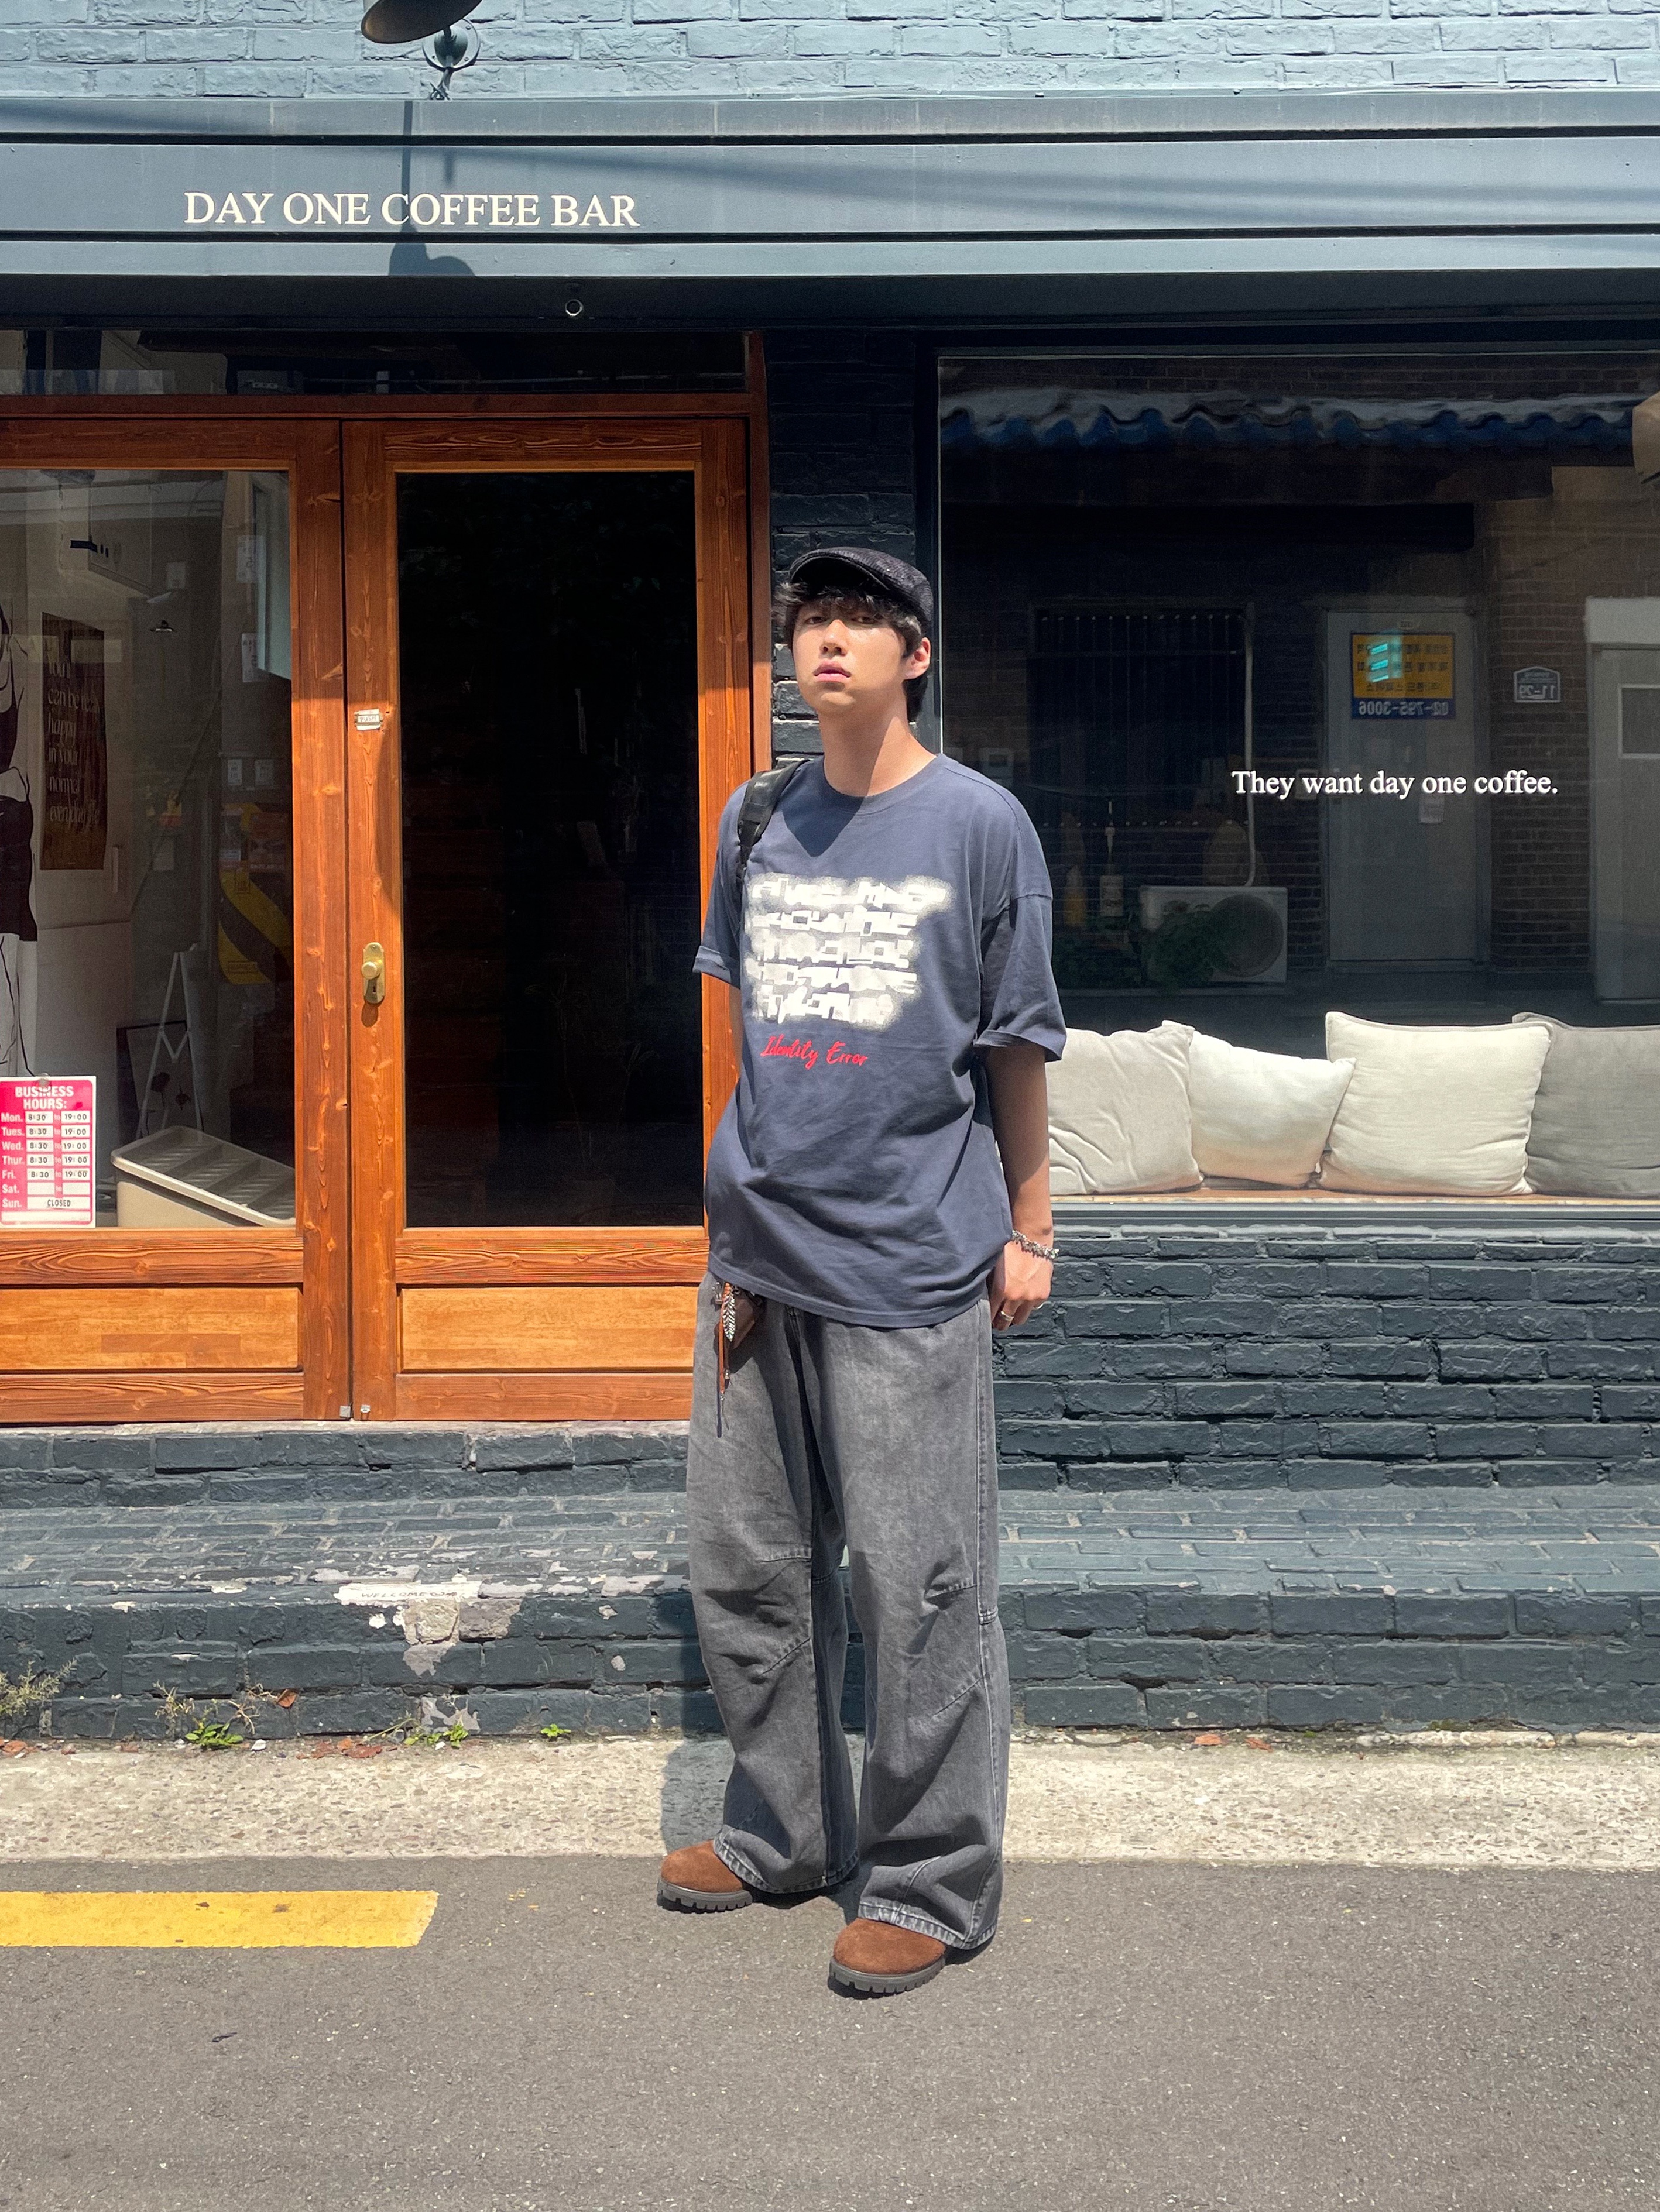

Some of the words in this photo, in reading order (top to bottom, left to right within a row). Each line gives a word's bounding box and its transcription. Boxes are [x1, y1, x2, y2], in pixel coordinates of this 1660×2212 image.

[184, 192, 274, 224] DAY
[283, 192, 371, 225] ONE
[382, 193, 541, 226] COFFEE
[551, 194, 640, 226] BAR
[1232, 770, 1295, 800] They
[1302, 773, 1363, 794] want
[1370, 770, 1415, 800] day
[1422, 777, 1467, 794] one
[1474, 770, 1558, 794] coffee.
[760, 1033, 819, 1070] Identity
[826, 1040, 868, 1066] Error
[15, 1086, 74, 1097] BUSINESS
[23, 1098, 67, 1110] HOURS:
[1, 1112, 23, 1122] Mon.
[1, 1126, 25, 1136] Tues.
[1, 1141, 24, 1150] Wed.
[2, 1155, 25, 1165] Thur.
[2, 1170, 16, 1179] Fri.
[2, 1184, 19, 1193] Sat.
[2, 1198, 22, 1208] Sun.
[47, 1199, 71, 1207] CLOSED
